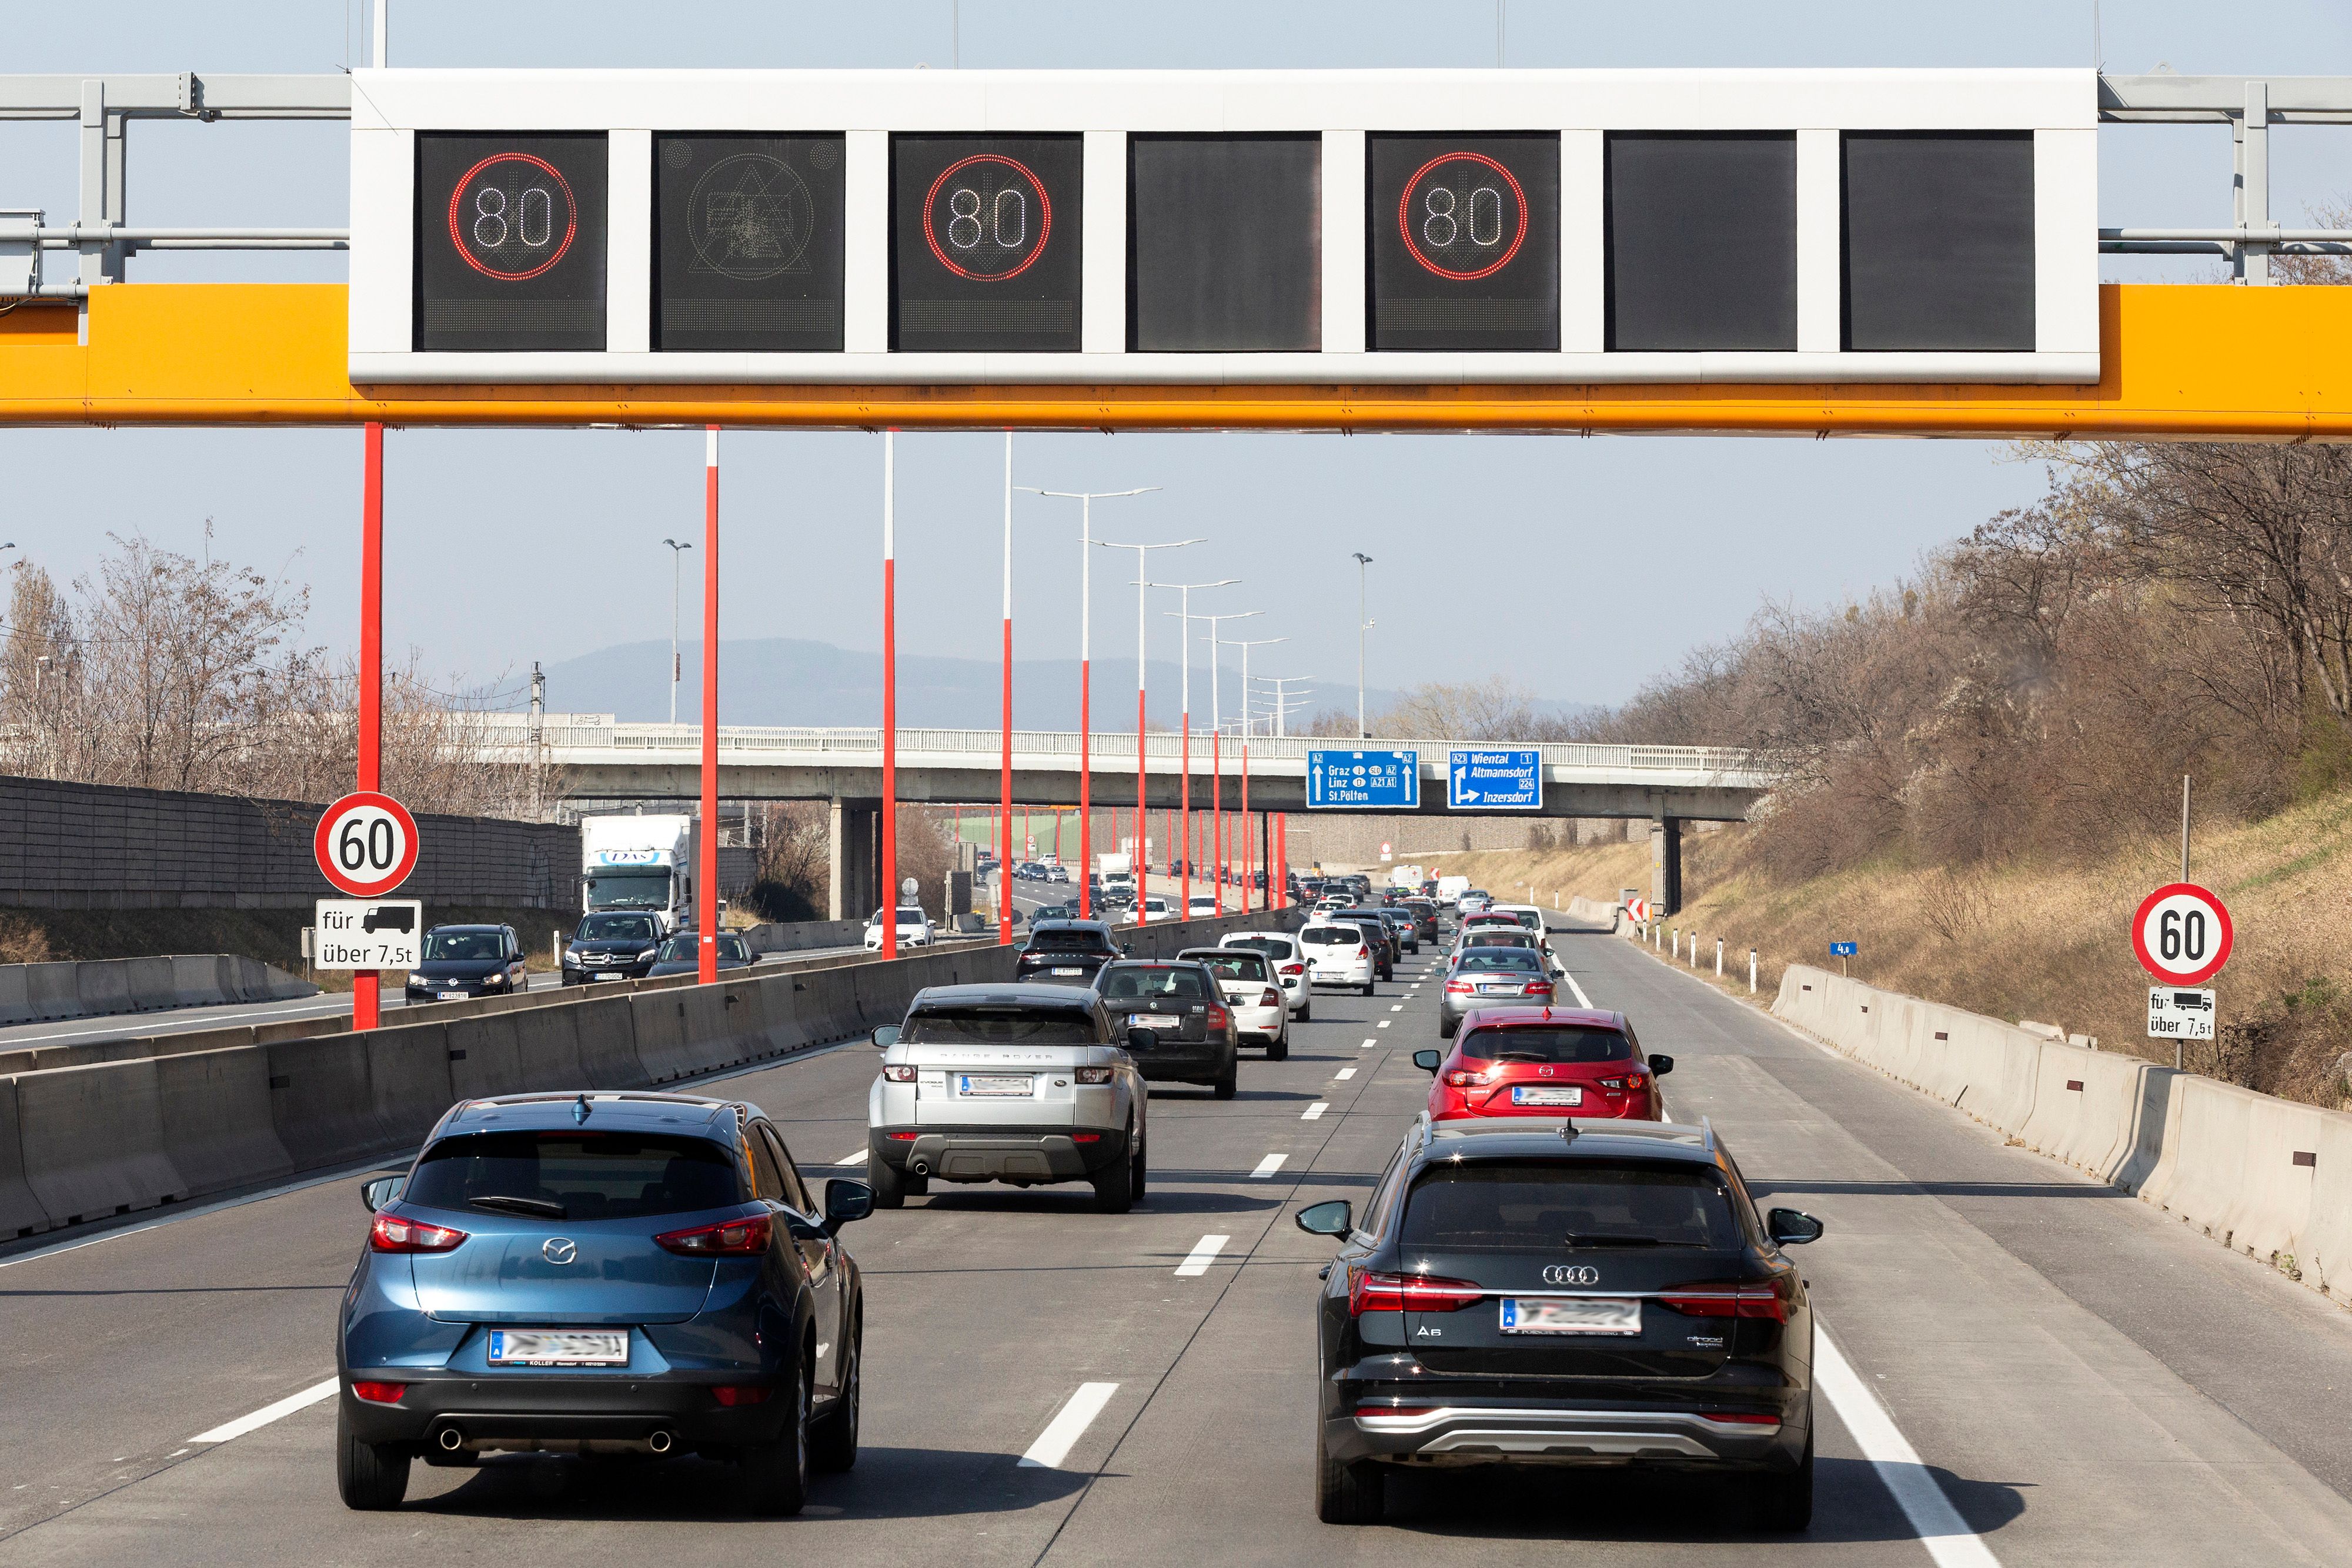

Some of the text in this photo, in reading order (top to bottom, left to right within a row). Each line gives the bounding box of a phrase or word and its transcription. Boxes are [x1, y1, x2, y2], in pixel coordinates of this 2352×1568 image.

[474, 188, 551, 247] 80
[948, 188, 1025, 248] 80
[1424, 187, 1501, 247] 80
[1314, 753, 1322, 763] A2
[1403, 754, 1412, 763] A2
[1471, 753, 1509, 764] Wiental
[1329, 765, 1350, 776] Graz
[1387, 766, 1396, 774] A2
[1471, 766, 1534, 778] Altmannsdorf
[1329, 777, 1348, 788] Linz
[1372, 778, 1385, 787] A21
[1387, 778, 1395, 787] A1
[1483, 791, 1534, 803] Inzersdorf
[339, 818, 394, 870] 60
[323, 911, 353, 929] für
[2160, 910, 2205, 960] 60
[324, 944, 370, 962] über
[1838, 944, 1849, 954] 4,0
[2151, 1016, 2180, 1032] über
[1416, 1326, 1441, 1336] A6
